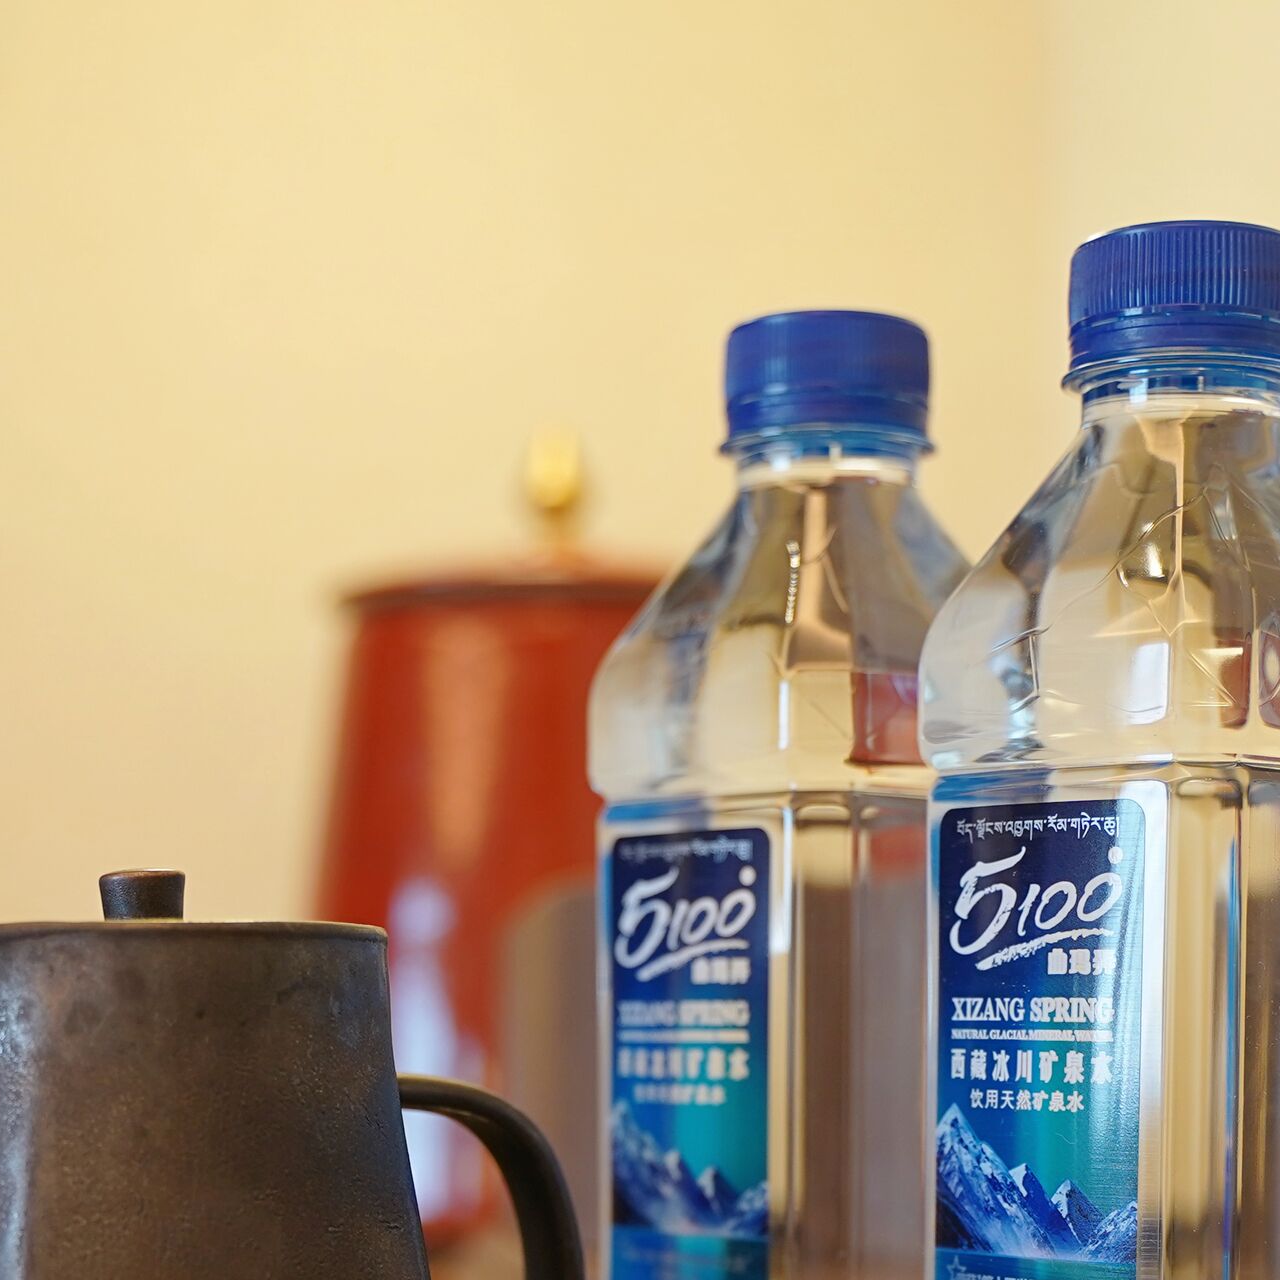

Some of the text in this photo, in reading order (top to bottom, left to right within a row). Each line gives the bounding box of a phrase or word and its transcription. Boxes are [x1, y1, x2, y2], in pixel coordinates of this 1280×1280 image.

[949, 846, 1123, 955] 5100
[615, 866, 757, 969] 5100
[951, 997, 1116, 1023] XIZANG SPRING
[951, 1028, 989, 1040] NATURAL
[990, 1028, 1029, 1041] GLACIAL
[951, 1048, 1114, 1085] 西藏冰川矿泉水
[970, 1089, 1085, 1112] 饮用天然矿泉水
